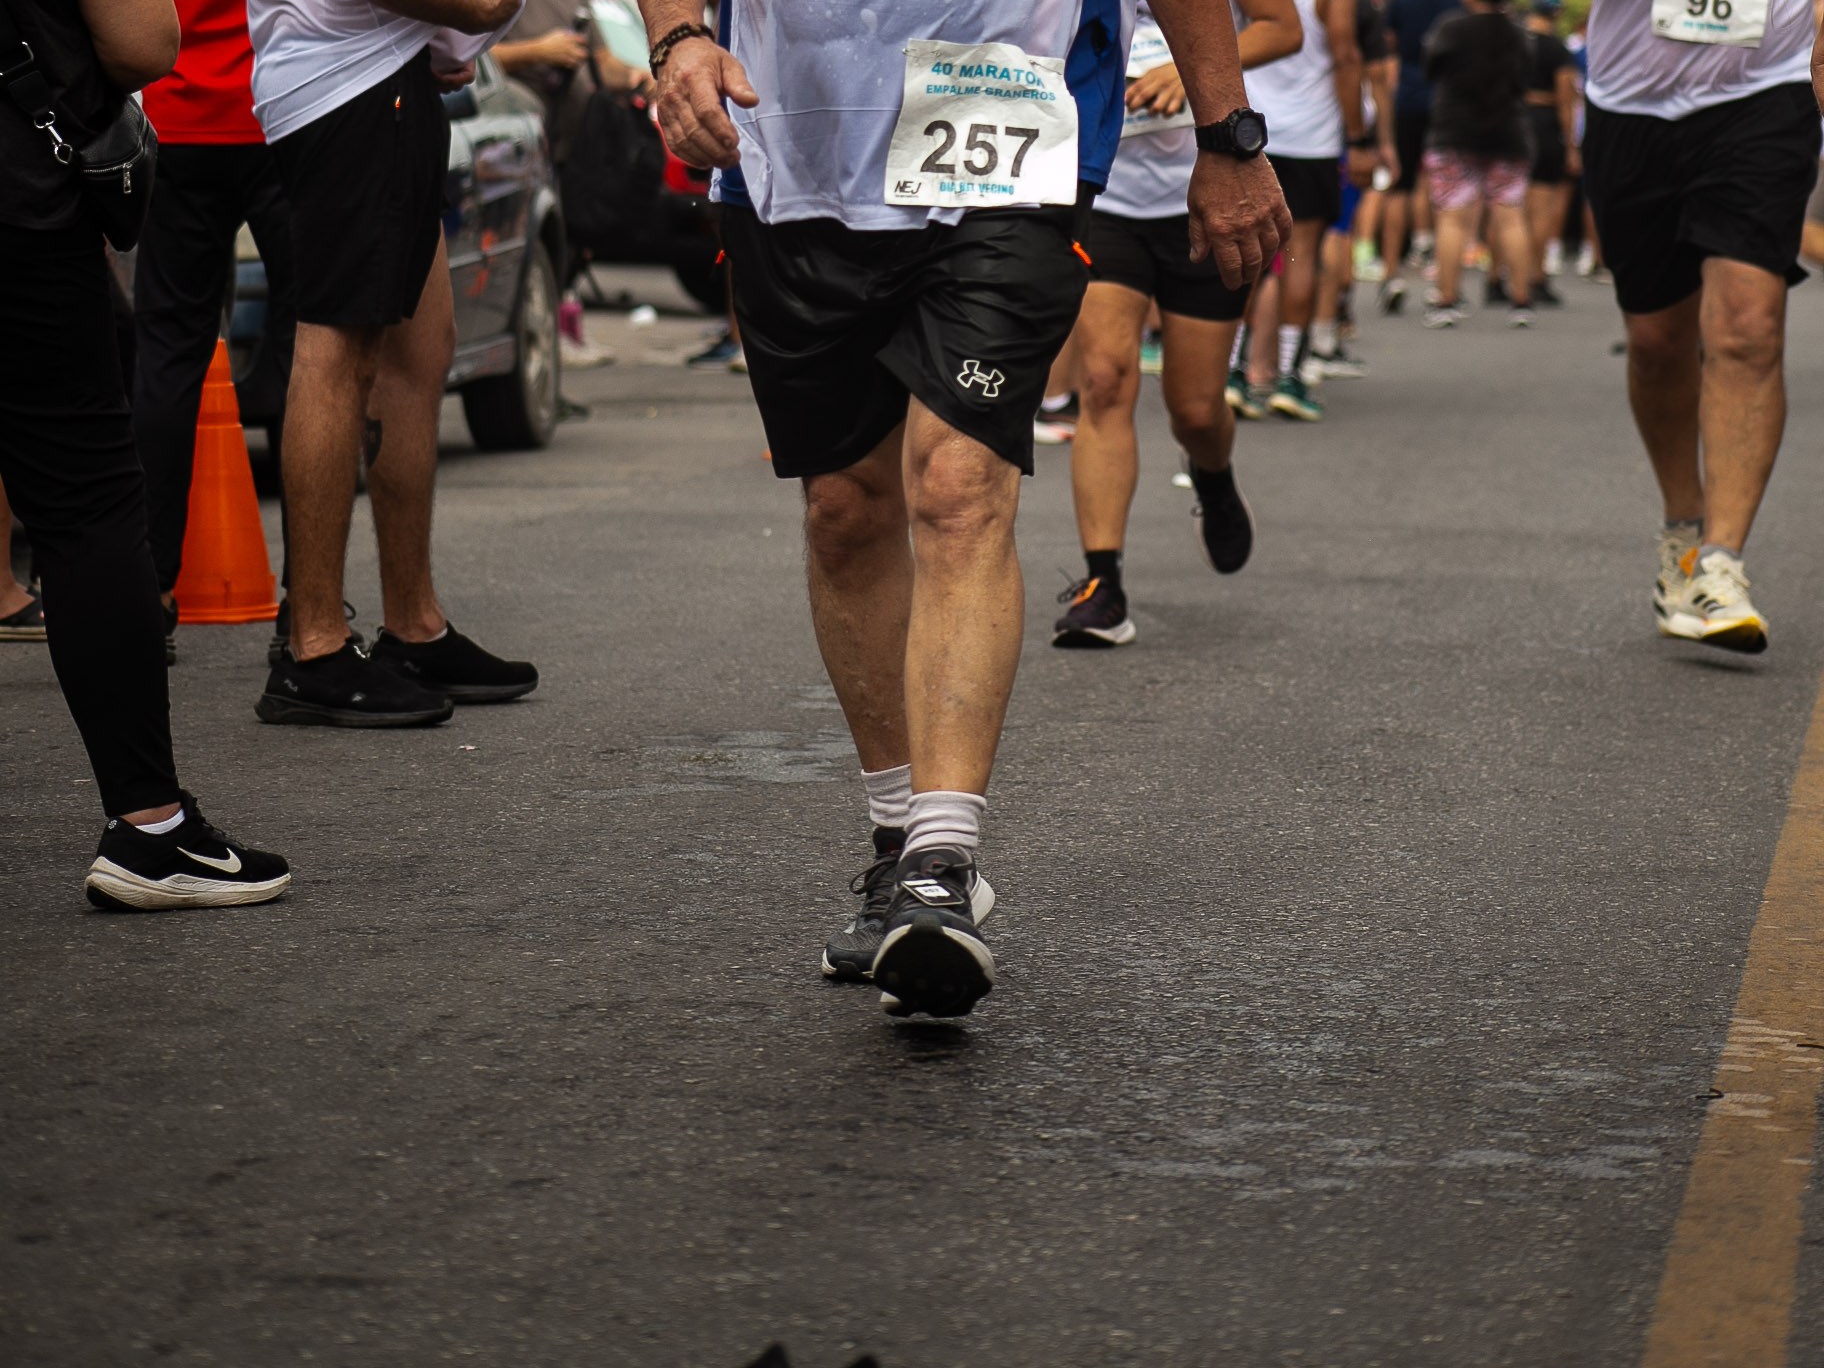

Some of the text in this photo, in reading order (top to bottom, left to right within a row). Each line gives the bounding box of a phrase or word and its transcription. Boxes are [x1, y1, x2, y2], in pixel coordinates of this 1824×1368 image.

[931, 62, 953, 76] 40
[926, 84, 1056, 101] EMPALME GRANEROS
[920, 120, 1040, 178] 257
[894, 181, 922, 194] NEJ
